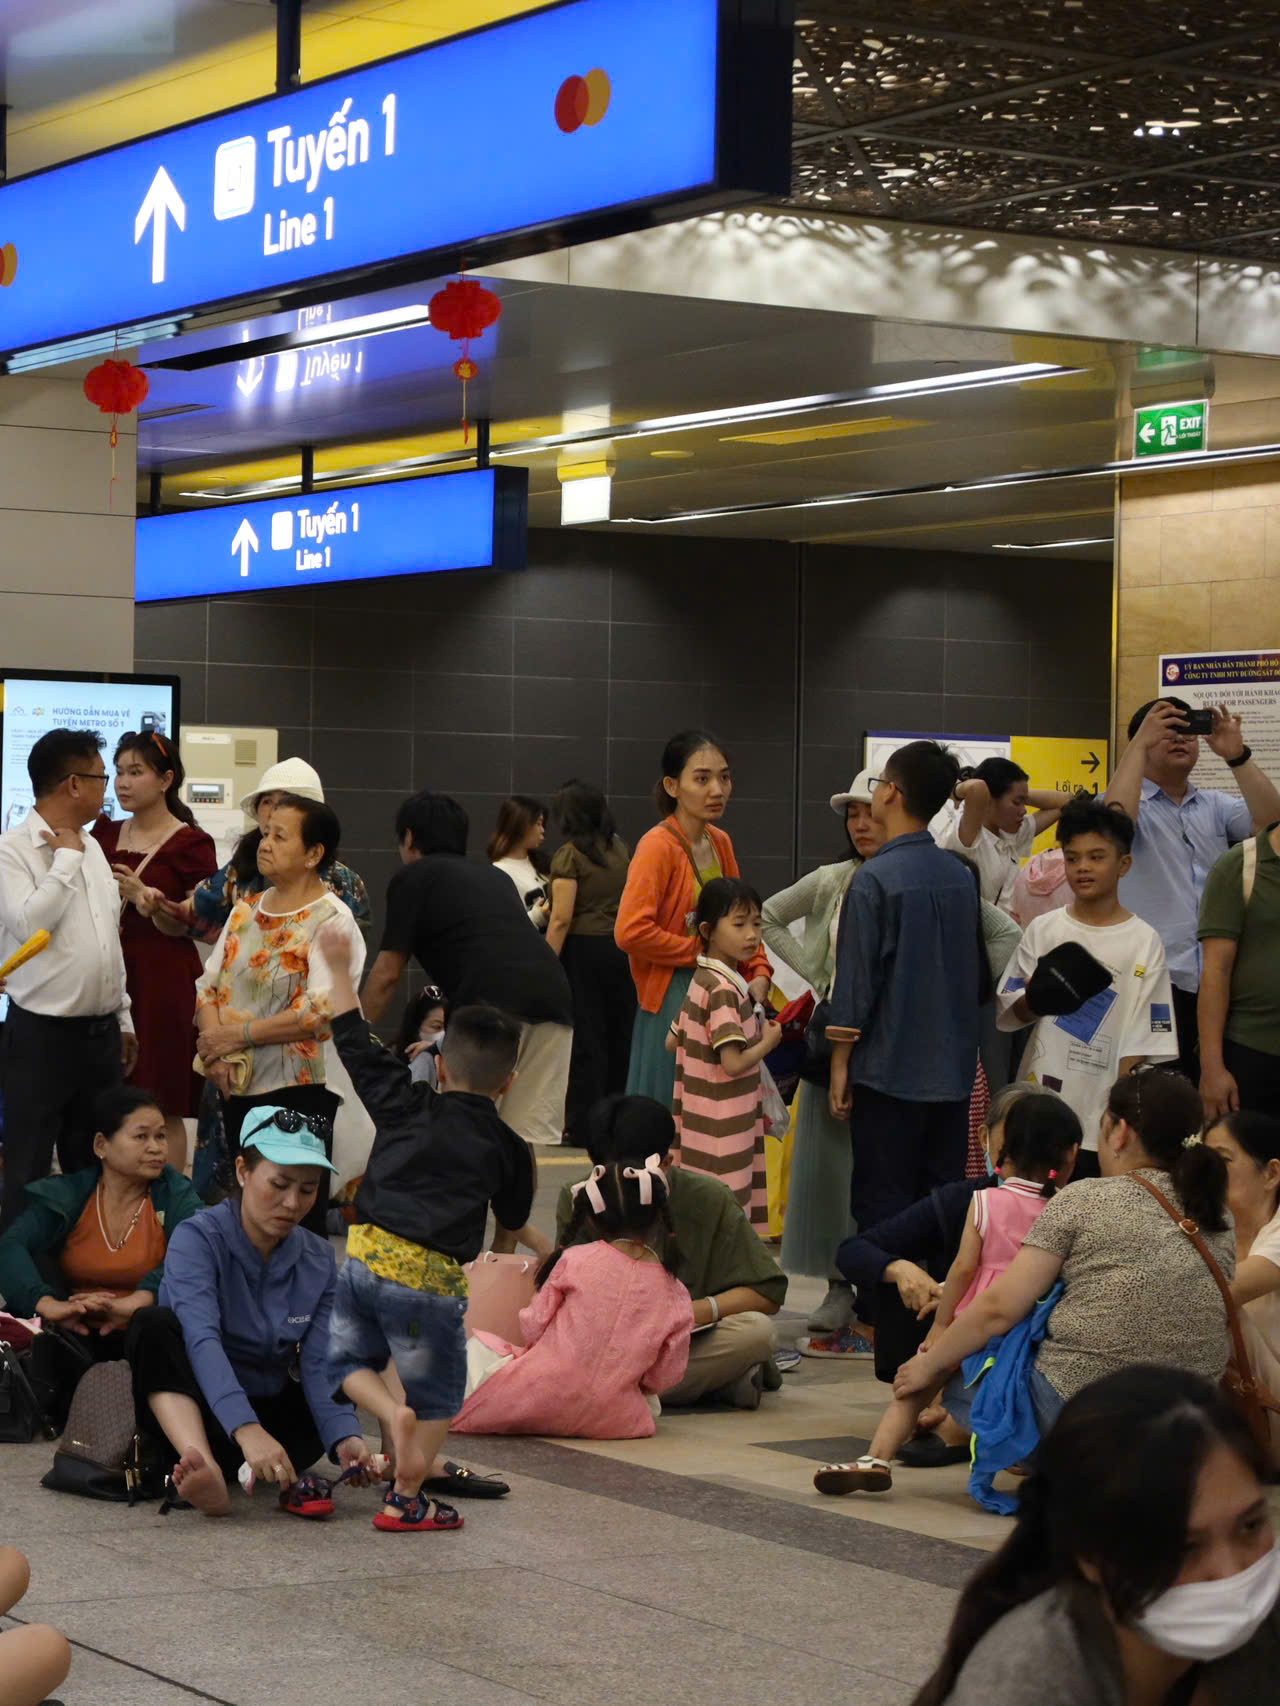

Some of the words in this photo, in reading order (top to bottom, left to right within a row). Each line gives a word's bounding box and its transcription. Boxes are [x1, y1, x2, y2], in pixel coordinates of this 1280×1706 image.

[267, 97, 369, 193] Tuyến
[382, 93, 396, 156] 1
[264, 209, 317, 256] Line
[323, 196, 334, 240] 1
[1180, 416, 1202, 430] EXIT
[297, 501, 347, 544] Tuyến
[351, 502, 359, 532] 1
[296, 549, 322, 571] Line
[324, 546, 331, 568] 1
[79, 719, 106, 727] METRO
